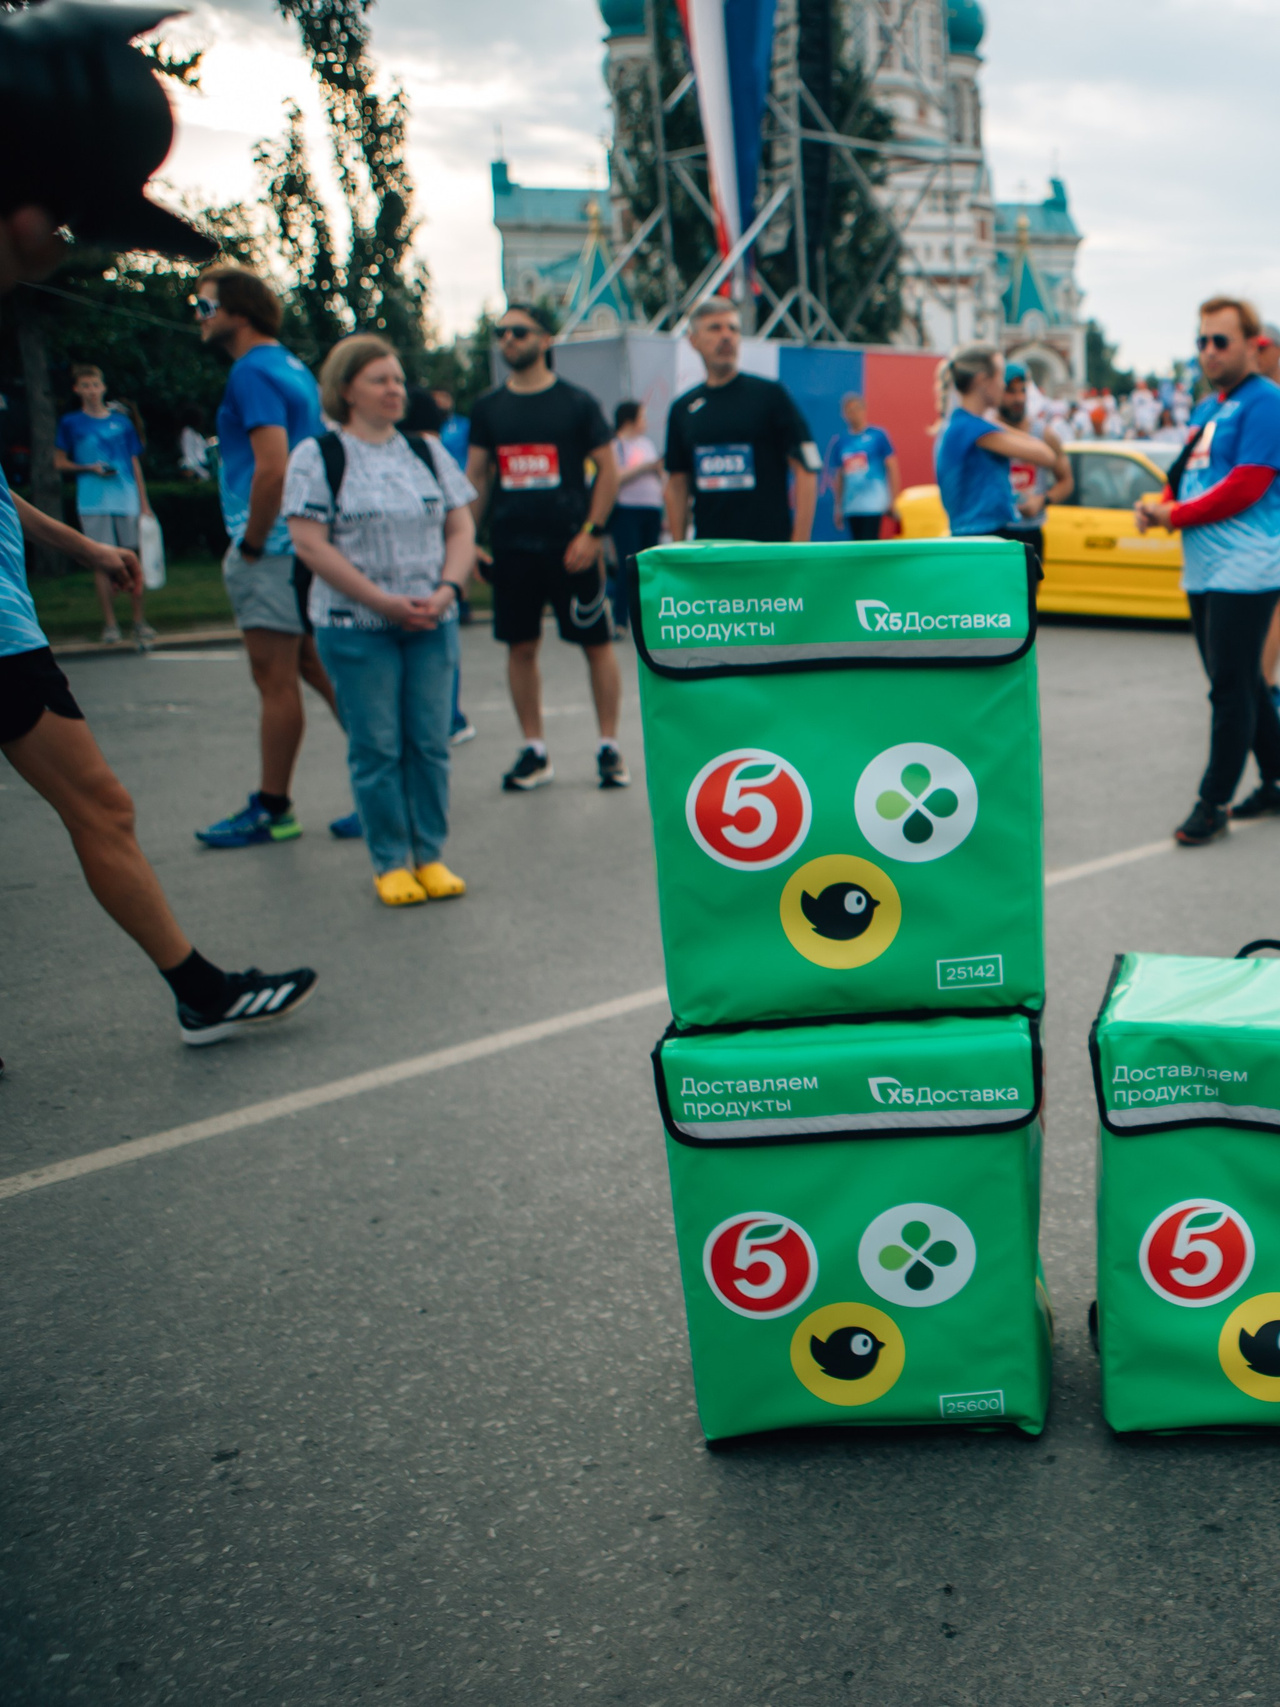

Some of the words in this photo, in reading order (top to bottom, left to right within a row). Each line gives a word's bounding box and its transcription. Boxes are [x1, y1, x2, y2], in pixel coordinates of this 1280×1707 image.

[658, 596, 804, 619] Доставляем
[660, 622, 775, 644] продукты
[720, 758, 783, 849] 5
[946, 963, 996, 981] 25142
[1112, 1064, 1248, 1084] Доставляем
[680, 1076, 819, 1097] Доставляем
[1113, 1084, 1219, 1106] продукты
[683, 1099, 791, 1120] продукты
[1169, 1206, 1229, 1288] 5
[732, 1219, 790, 1300] 5
[946, 1398, 1000, 1414] 25600
